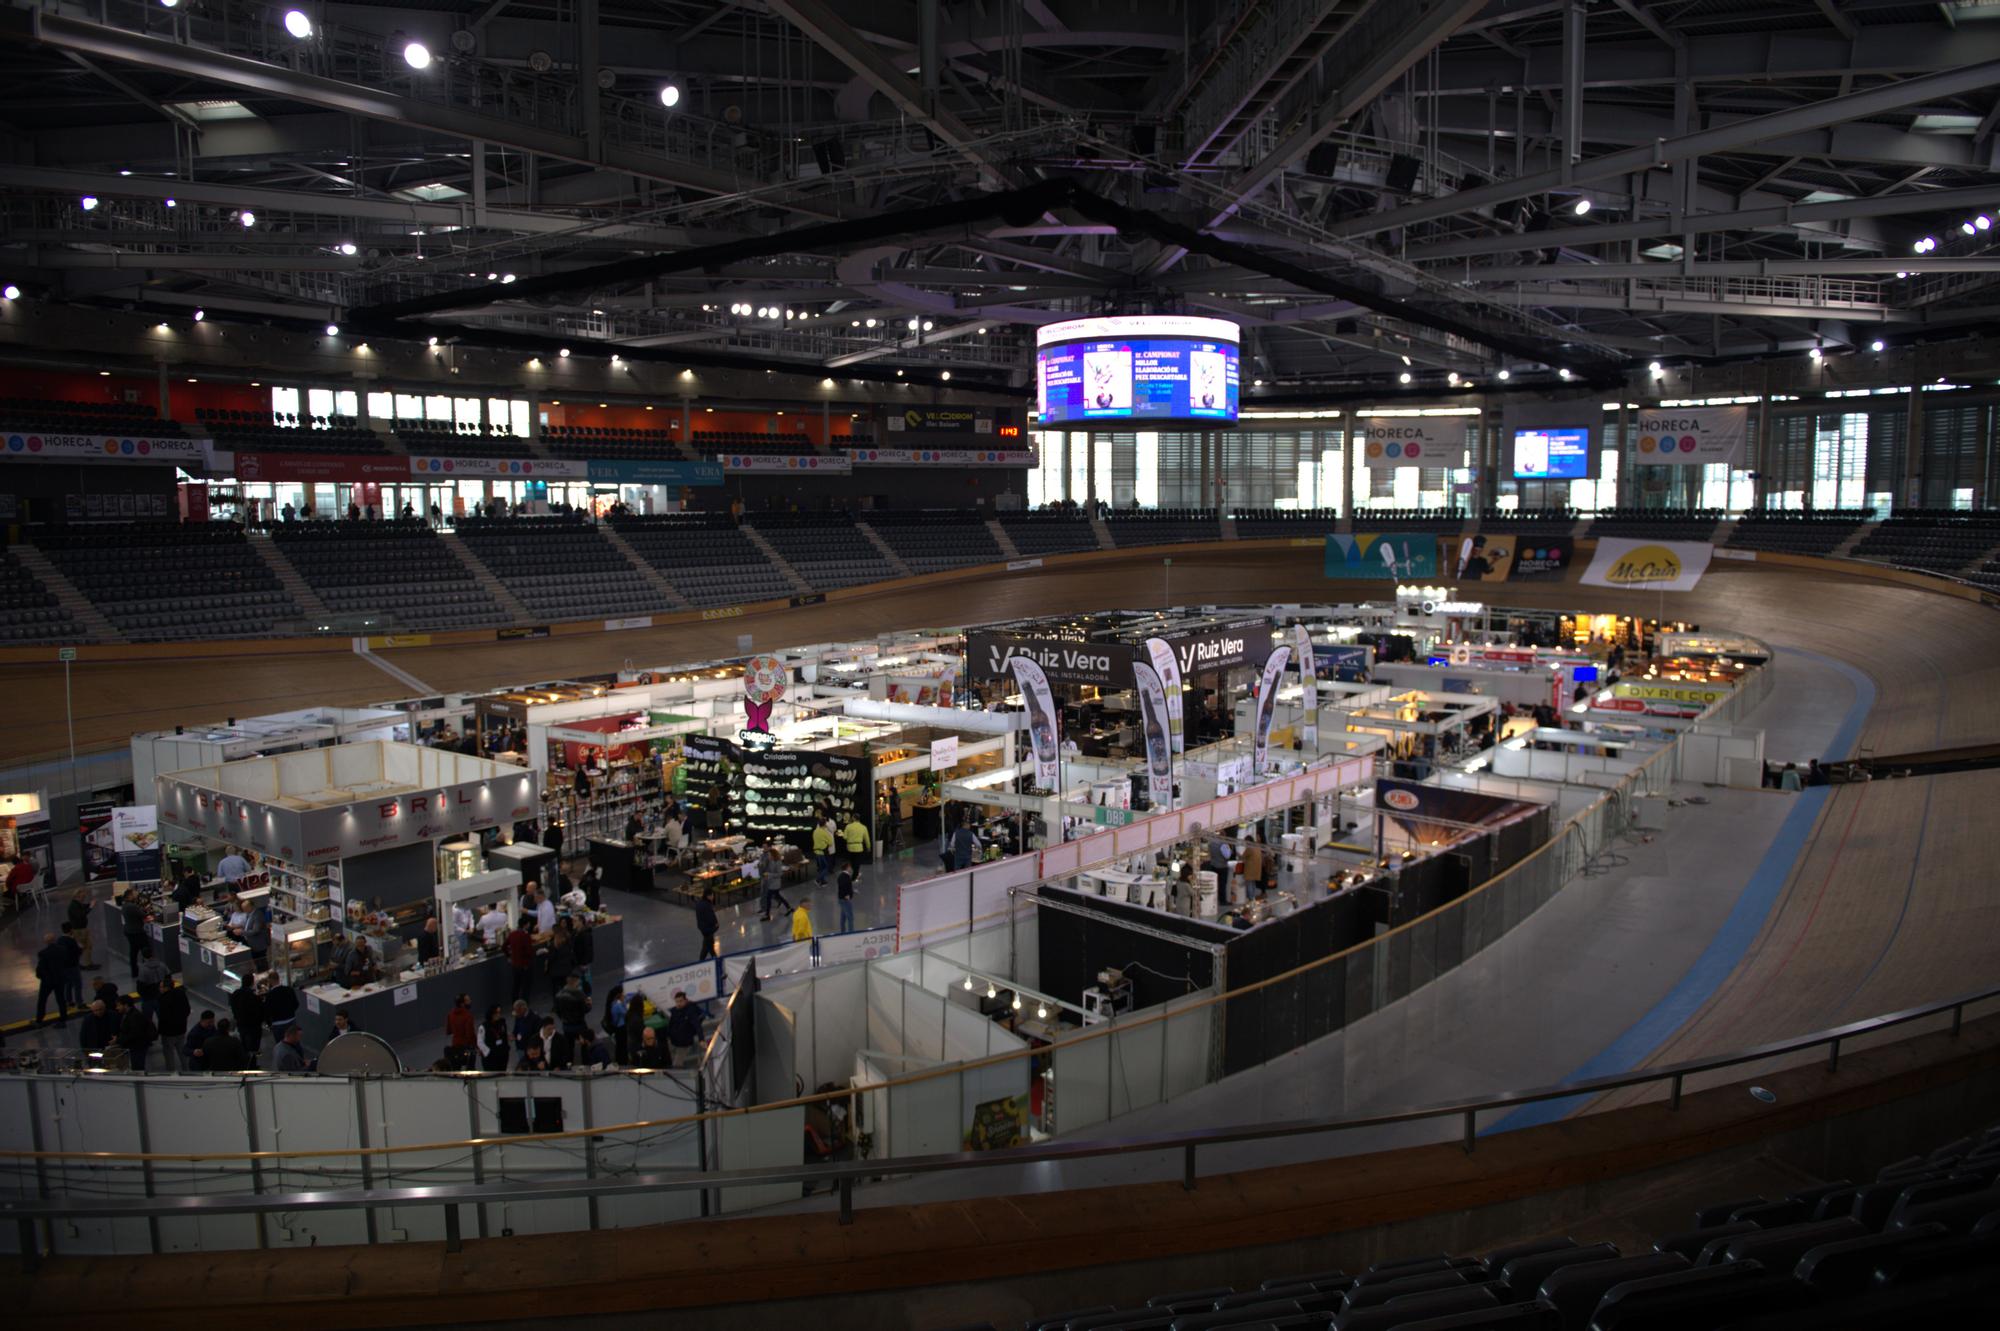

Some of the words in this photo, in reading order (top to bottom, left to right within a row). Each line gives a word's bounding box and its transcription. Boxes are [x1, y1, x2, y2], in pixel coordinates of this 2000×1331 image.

[1640, 419, 1700, 432] HORECA
[1366, 427, 1424, 439] HORECA
[44, 436, 93, 447] HORECA
[152, 440, 194, 450] HORECA
[455, 459, 490, 469] HORECA
[695, 466, 720, 476] VERA
[1612, 558, 1676, 578] McCain
[1198, 640, 1220, 661] Ruiz
[1220, 638, 1244, 656] Vera
[1063, 649, 1110, 672] Vera
[378, 789, 472, 819] BRIL
[1106, 809, 1125, 826] DBB
